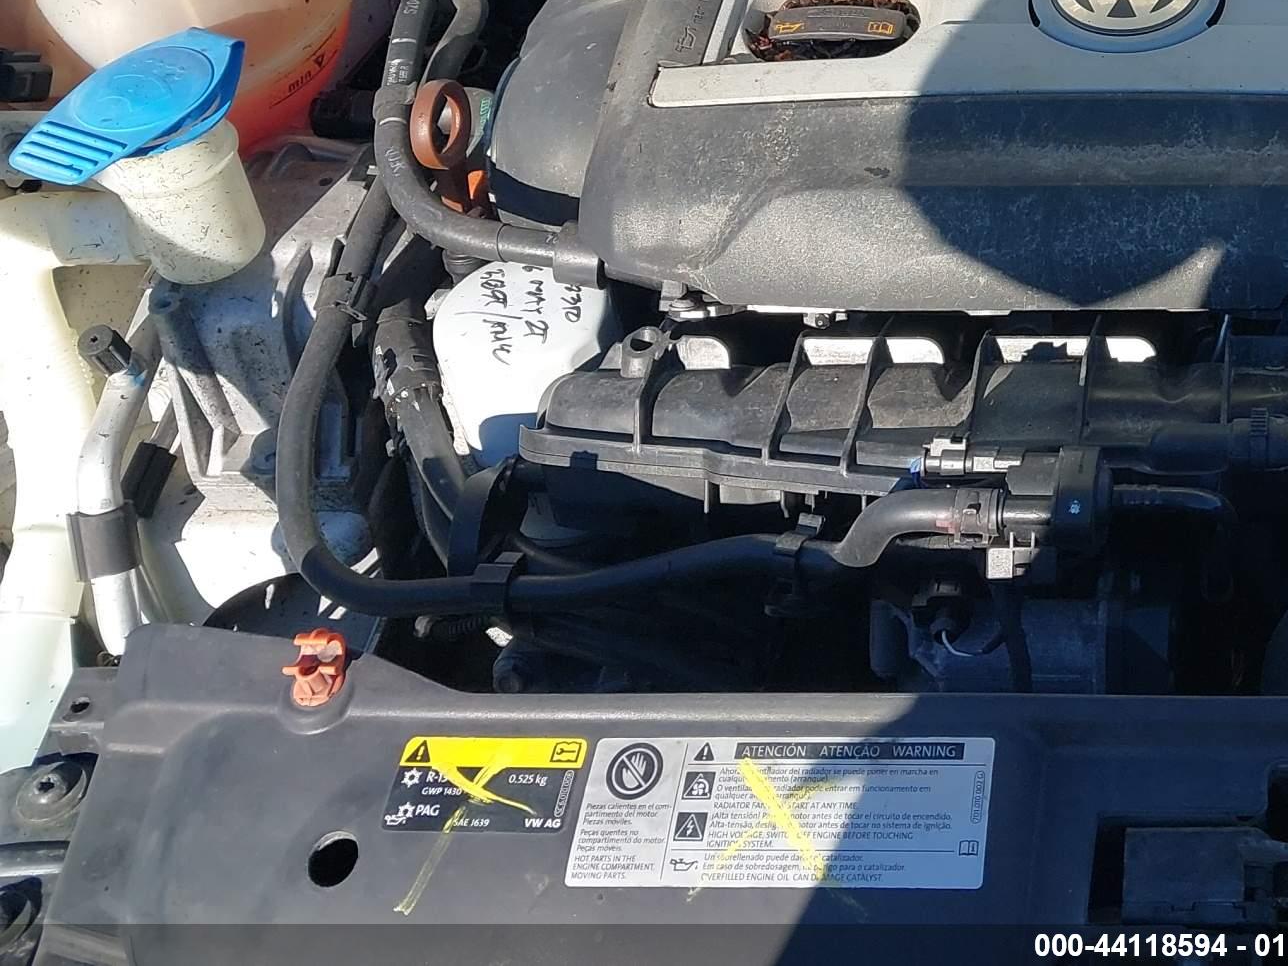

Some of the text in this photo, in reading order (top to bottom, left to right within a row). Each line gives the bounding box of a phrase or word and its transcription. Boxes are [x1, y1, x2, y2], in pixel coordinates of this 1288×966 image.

[288, 70, 312, 92] min
[742, 743, 956, 760] ATENCIÓN ATENÇÃO WARNING
[842, 768, 865, 777] puede
[508, 774, 548, 786] 0.525 kg
[421, 787, 462, 796] GWP 1430
[862, 785, 918, 793] funcionamento
[714, 793, 747, 801] qualquer
[415, 805, 440, 816] PAG
[584, 811, 624, 819] partimento
[453, 819, 468, 827] SAE
[525, 818, 561, 828] VW AG
[839, 821, 849, 829] de
[580, 829, 599, 837] Peças
[812, 831, 841, 839] ENGINE
[842, 831, 870, 839] BEFORE
[578, 837, 632, 845] compartimento
[576, 845, 595, 853] Peças
[704, 853, 715, 861] Un
[765, 853, 789, 863] puede
[703, 862, 714, 870] Em
[734, 862, 744, 870] de
[746, 873, 775, 881] ENGINE
[776, 873, 789, 881] OIL
[792, 873, 809, 881] CAN
